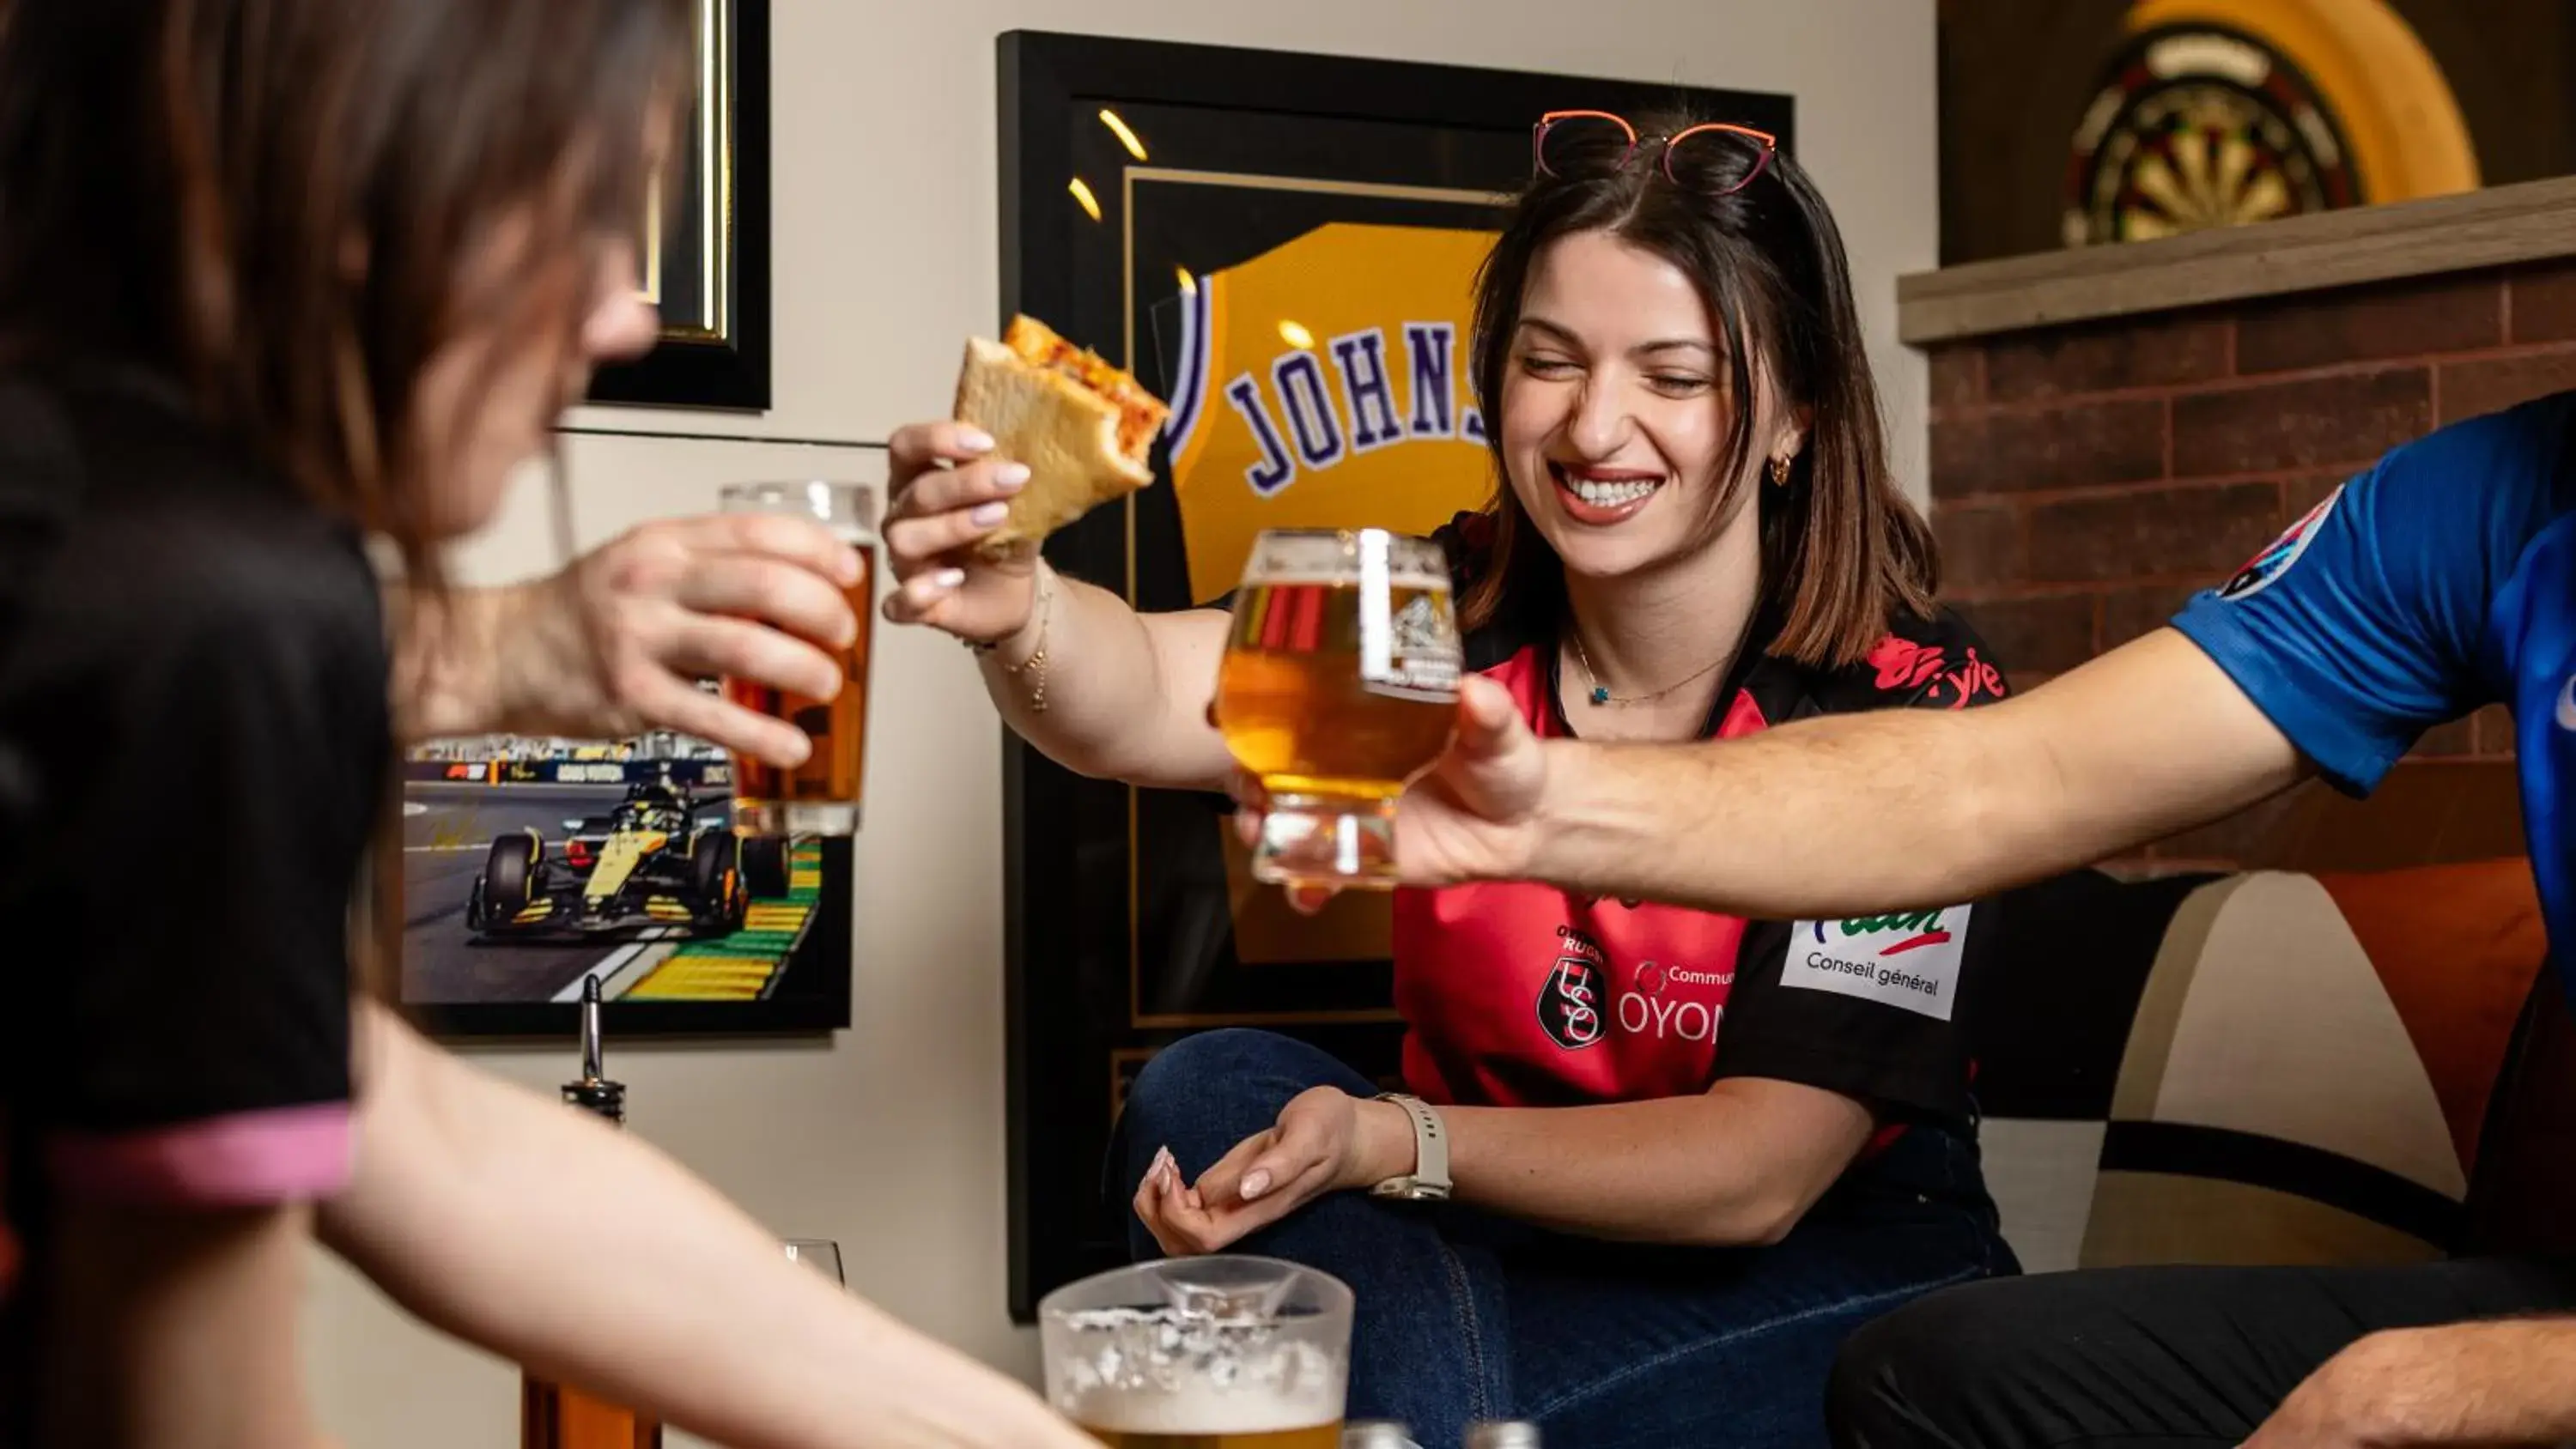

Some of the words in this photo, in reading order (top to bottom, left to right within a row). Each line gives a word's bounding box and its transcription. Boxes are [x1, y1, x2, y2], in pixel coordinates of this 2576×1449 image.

[1668, 965, 1735, 985] Commu
[1807, 952, 1875, 979] Conseil
[1878, 969, 1939, 997] général
